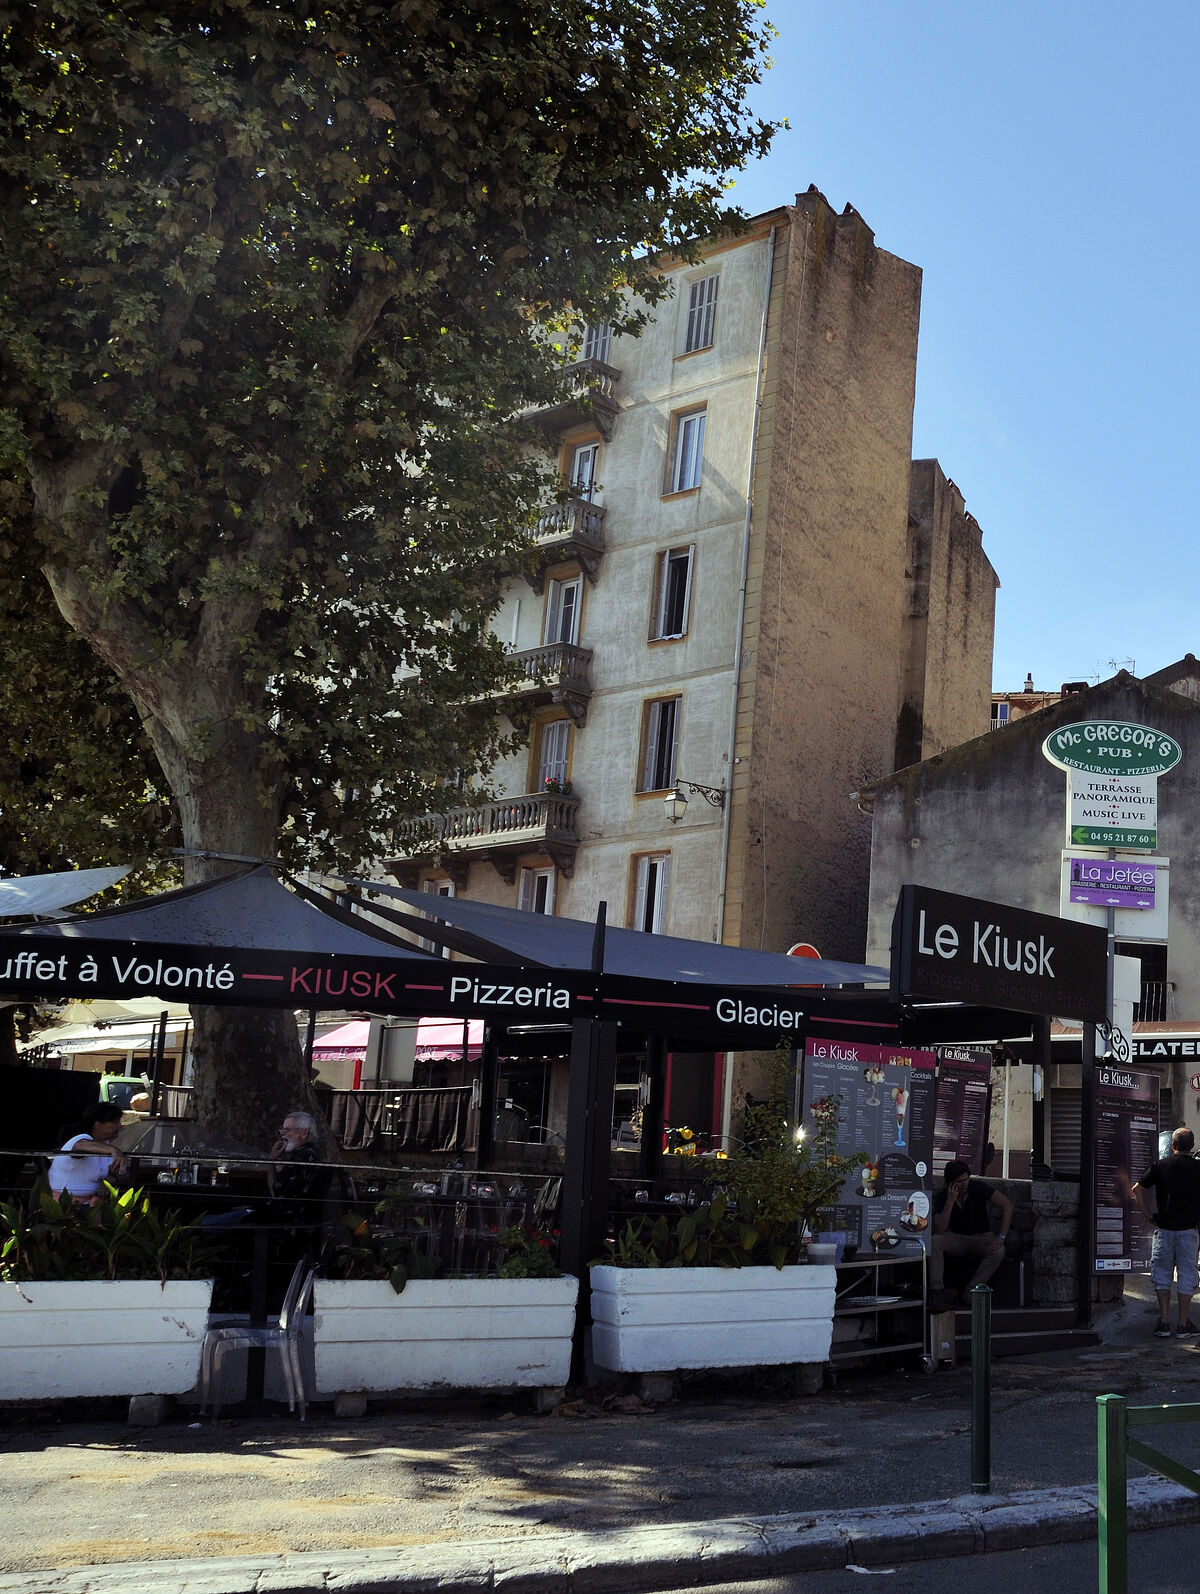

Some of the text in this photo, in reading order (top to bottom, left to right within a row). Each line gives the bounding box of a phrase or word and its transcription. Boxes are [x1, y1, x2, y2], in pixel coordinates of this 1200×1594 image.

[1056, 725, 1172, 757] Mc GREGOR'S
[1097, 746, 1133, 758] PUB
[1063, 756, 1165, 775] RESTAURANT PIZZERIA
[1088, 783, 1142, 794] TERRASSE
[1073, 793, 1155, 805] PANORAMIQUE
[1082, 810, 1146, 821] MUSIC LIVE
[1091, 832, 1149, 844] 04 95 21 87 60
[1082, 864, 1154, 885] La Jetée
[918, 909, 1056, 978] Le Kiusk
[78, 955, 98, 982] à
[112, 956, 235, 990] Volonté
[290, 967, 397, 999] KIUSK
[450, 976, 571, 1008] Pizzeria
[716, 997, 804, 1030] Glacier
[916, 966, 1101, 1012] Brasserie Glacier Pizzeria
[813, 1041, 859, 1062] Le Kiusk
[945, 1048, 953, 1059] Le
[910, 1071, 932, 1080] Cocktails
[1099, 1070, 1109, 1083] Le
[887, 1194, 908, 1202] Desserts
